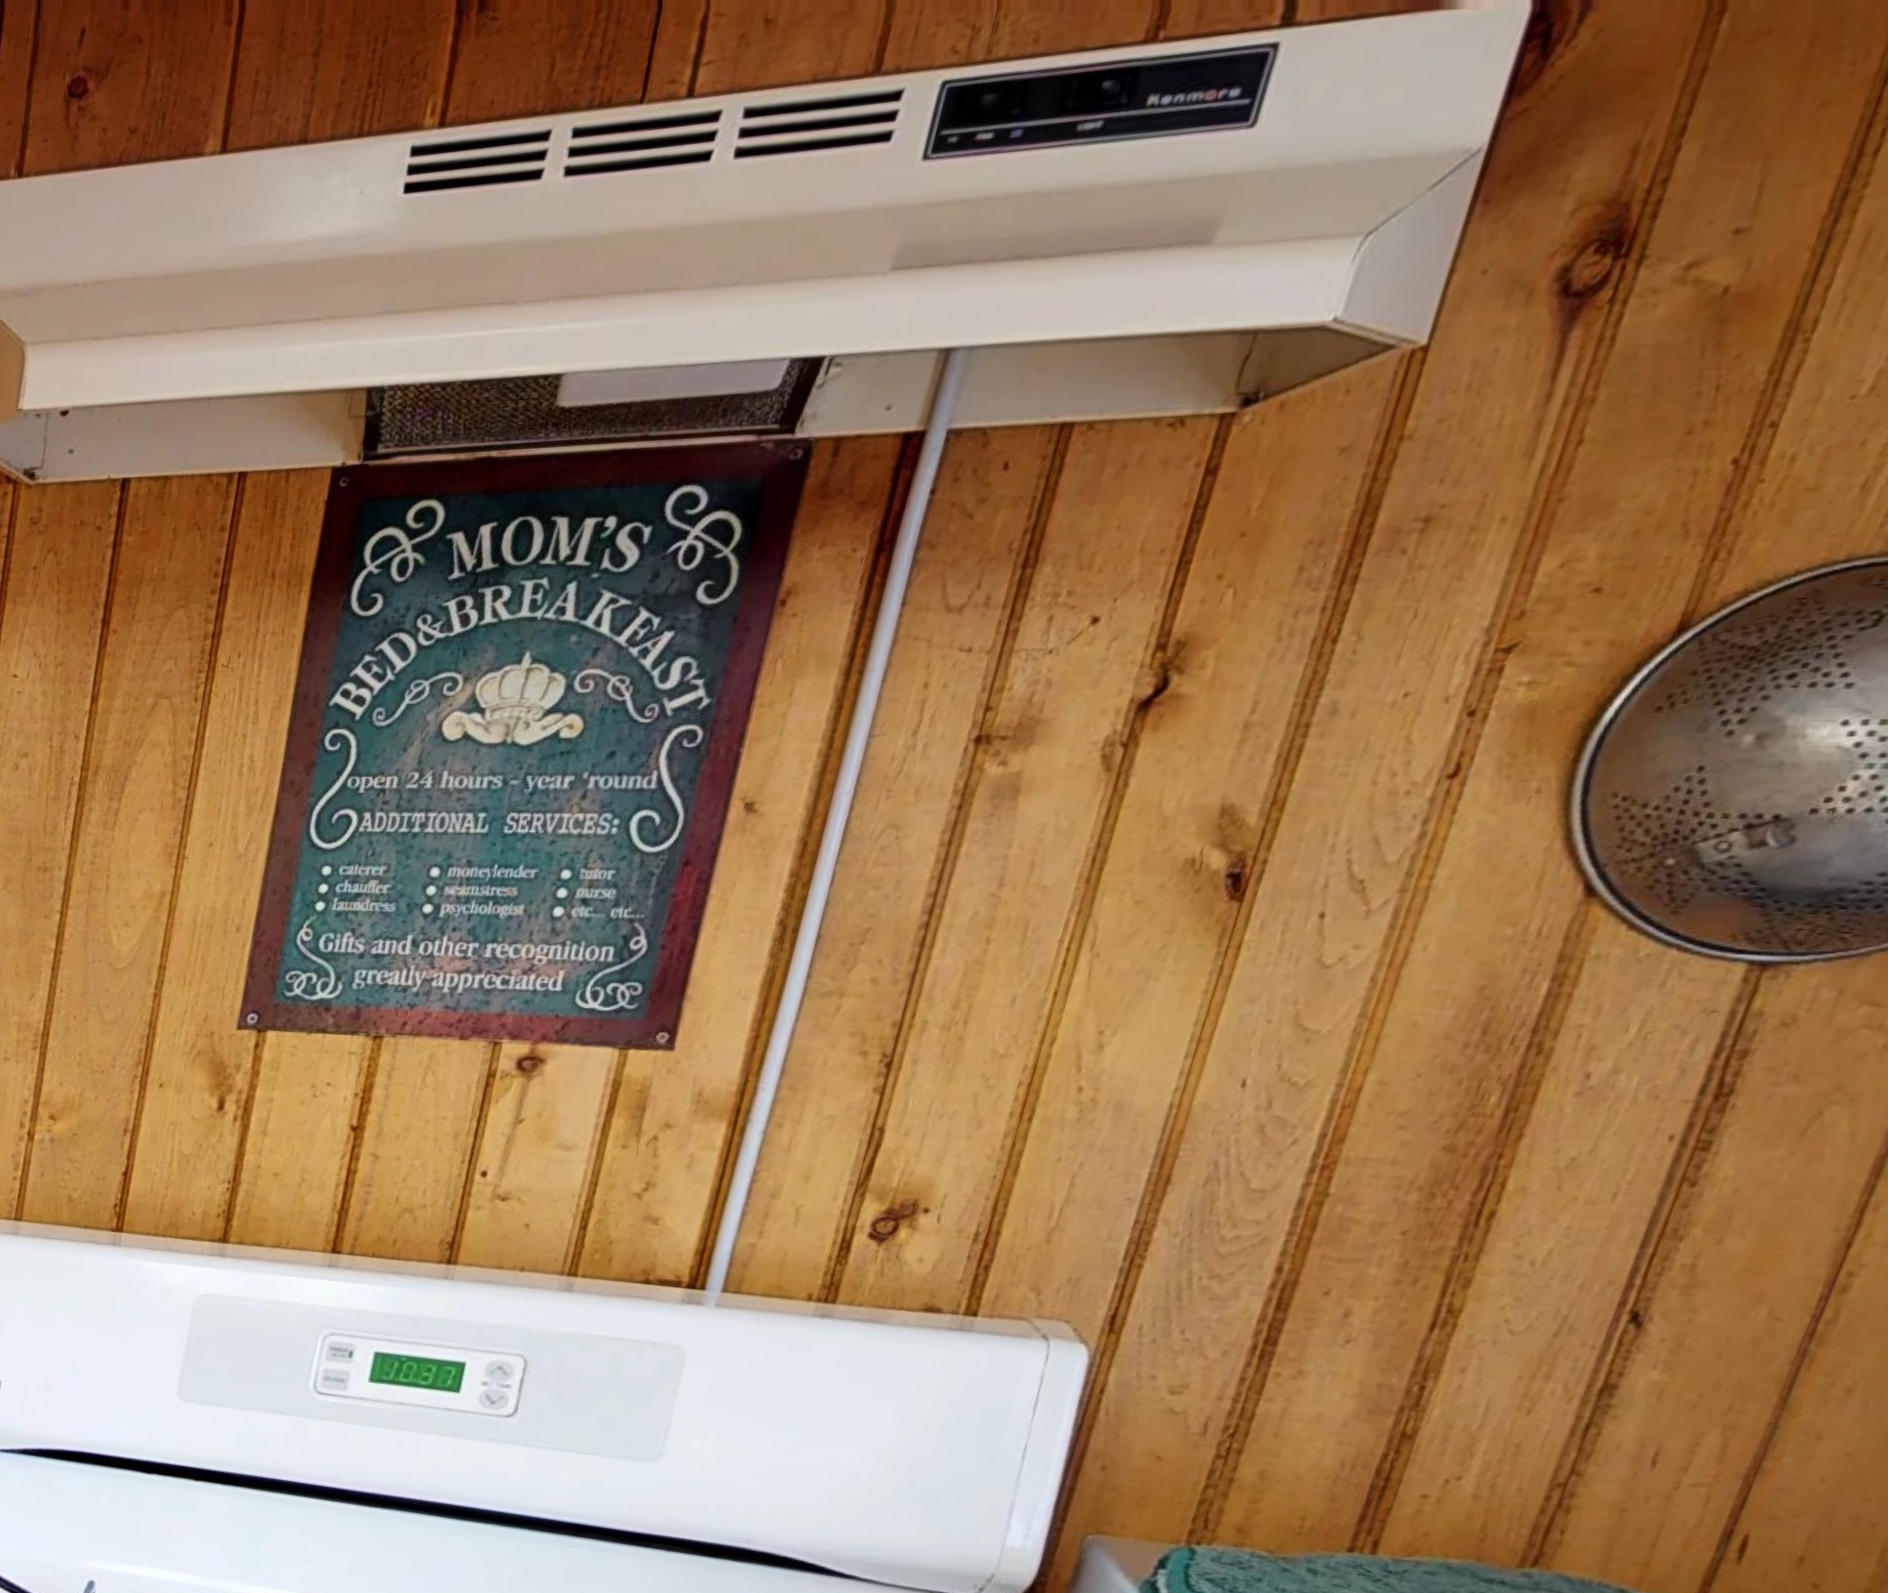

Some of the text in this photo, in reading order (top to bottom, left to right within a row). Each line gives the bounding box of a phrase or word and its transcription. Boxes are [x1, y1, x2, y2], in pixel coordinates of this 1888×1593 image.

[1146, 86, 1243, 109] Kenmore
[446, 515, 652, 580] MOM'S
[346, 773, 398, 791] open
[405, 771, 433, 789] 24
[440, 771, 504, 790] hours
[524, 773, 575, 794] year
[358, 812, 621, 835] ADDITIONAL SERVICES:
[338, 863, 389, 876] caterer
[447, 865, 539, 880] moneylender
[579, 867, 615, 880] tutor
[443, 884, 519, 897] seamstress
[575, 888, 617, 900] nurse
[331, 899, 396, 912] laundress
[439, 902, 525, 917] psychologist
[318, 933, 616, 965] Gifts and other recognition
[352, 966, 565, 993] greatly appreciated
